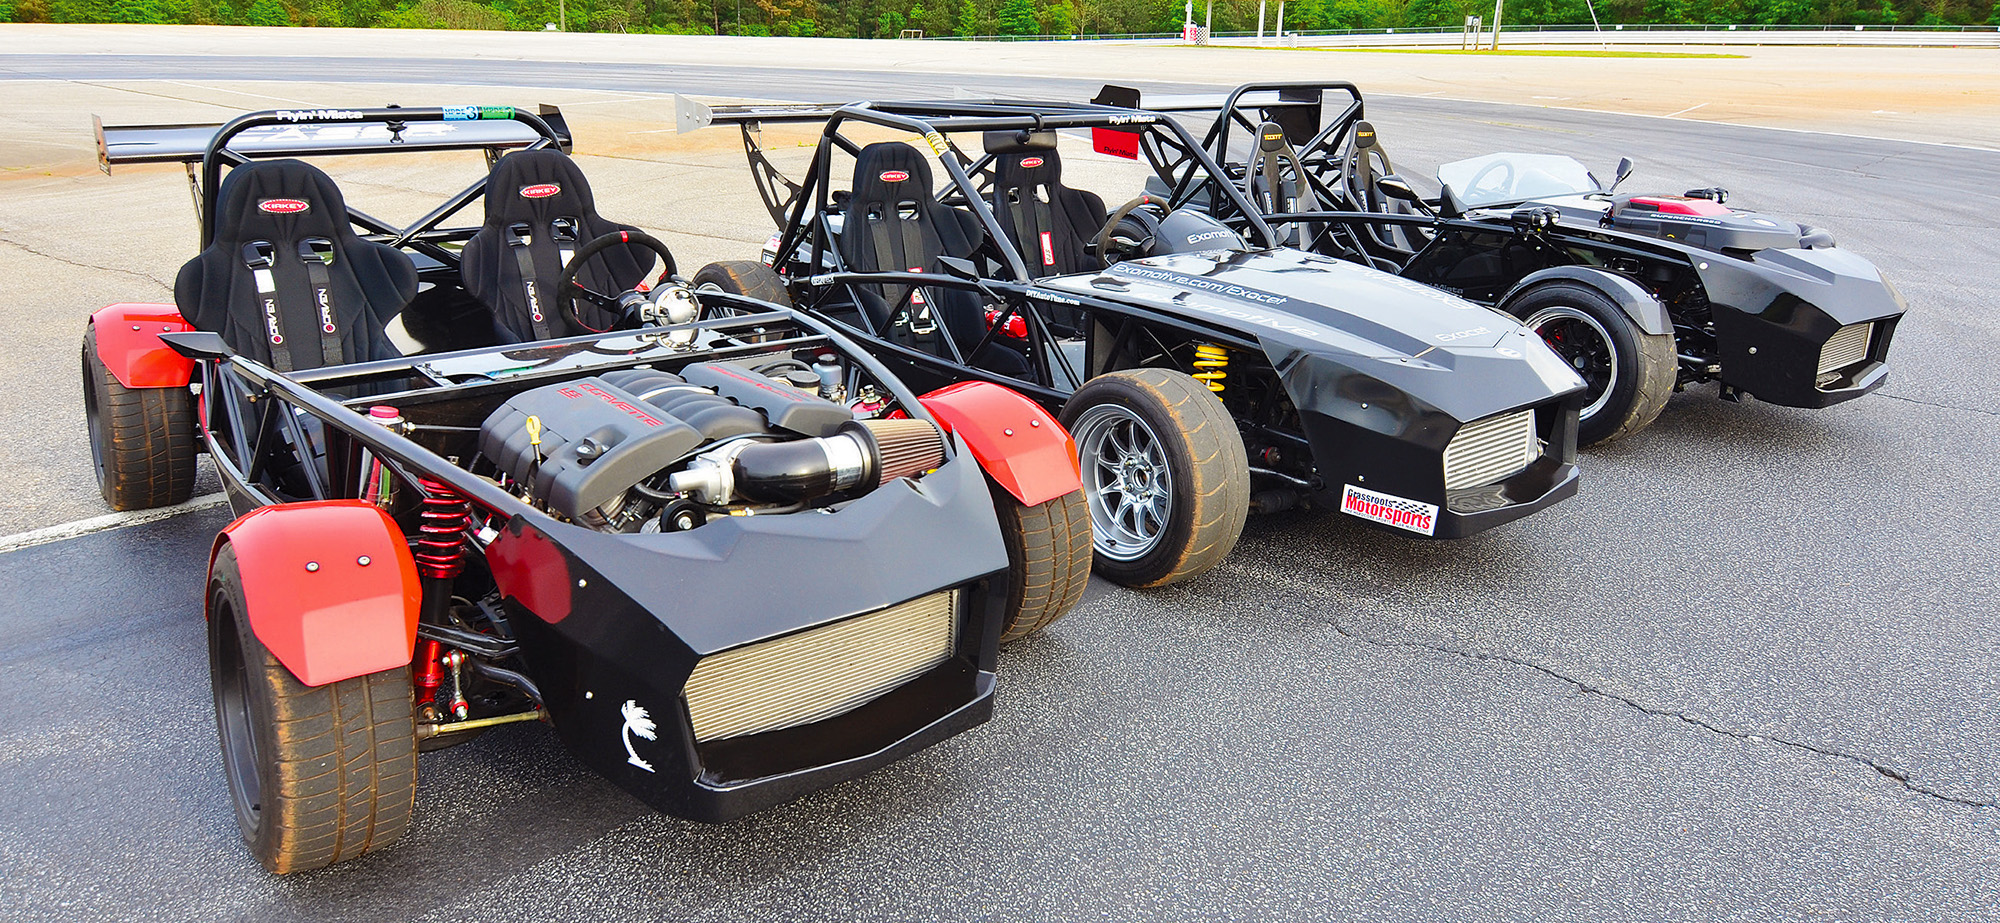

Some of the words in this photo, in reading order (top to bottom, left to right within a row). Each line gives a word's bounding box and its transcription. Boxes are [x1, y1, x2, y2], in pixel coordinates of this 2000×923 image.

[276, 110, 317, 122] Flyin'
[318, 109, 364, 120] Miata
[466, 105, 477, 120] 3
[1108, 114, 1130, 125] Flyin'
[1131, 114, 1156, 123] Miata
[1103, 146, 1119, 154] Flyin'
[1119, 148, 1137, 158] Miata
[523, 187, 557, 195] KIRKEY
[1112, 263, 1288, 305] Exomotive.com/Exocet
[1025, 289, 1081, 306] DIYAutoTune.com
[1435, 326, 1492, 342] Exocet
[578, 383, 664, 427] CORVETTE
[1347, 488, 1393, 508] Grassroots
[1345, 495, 1431, 530] Motorsports
